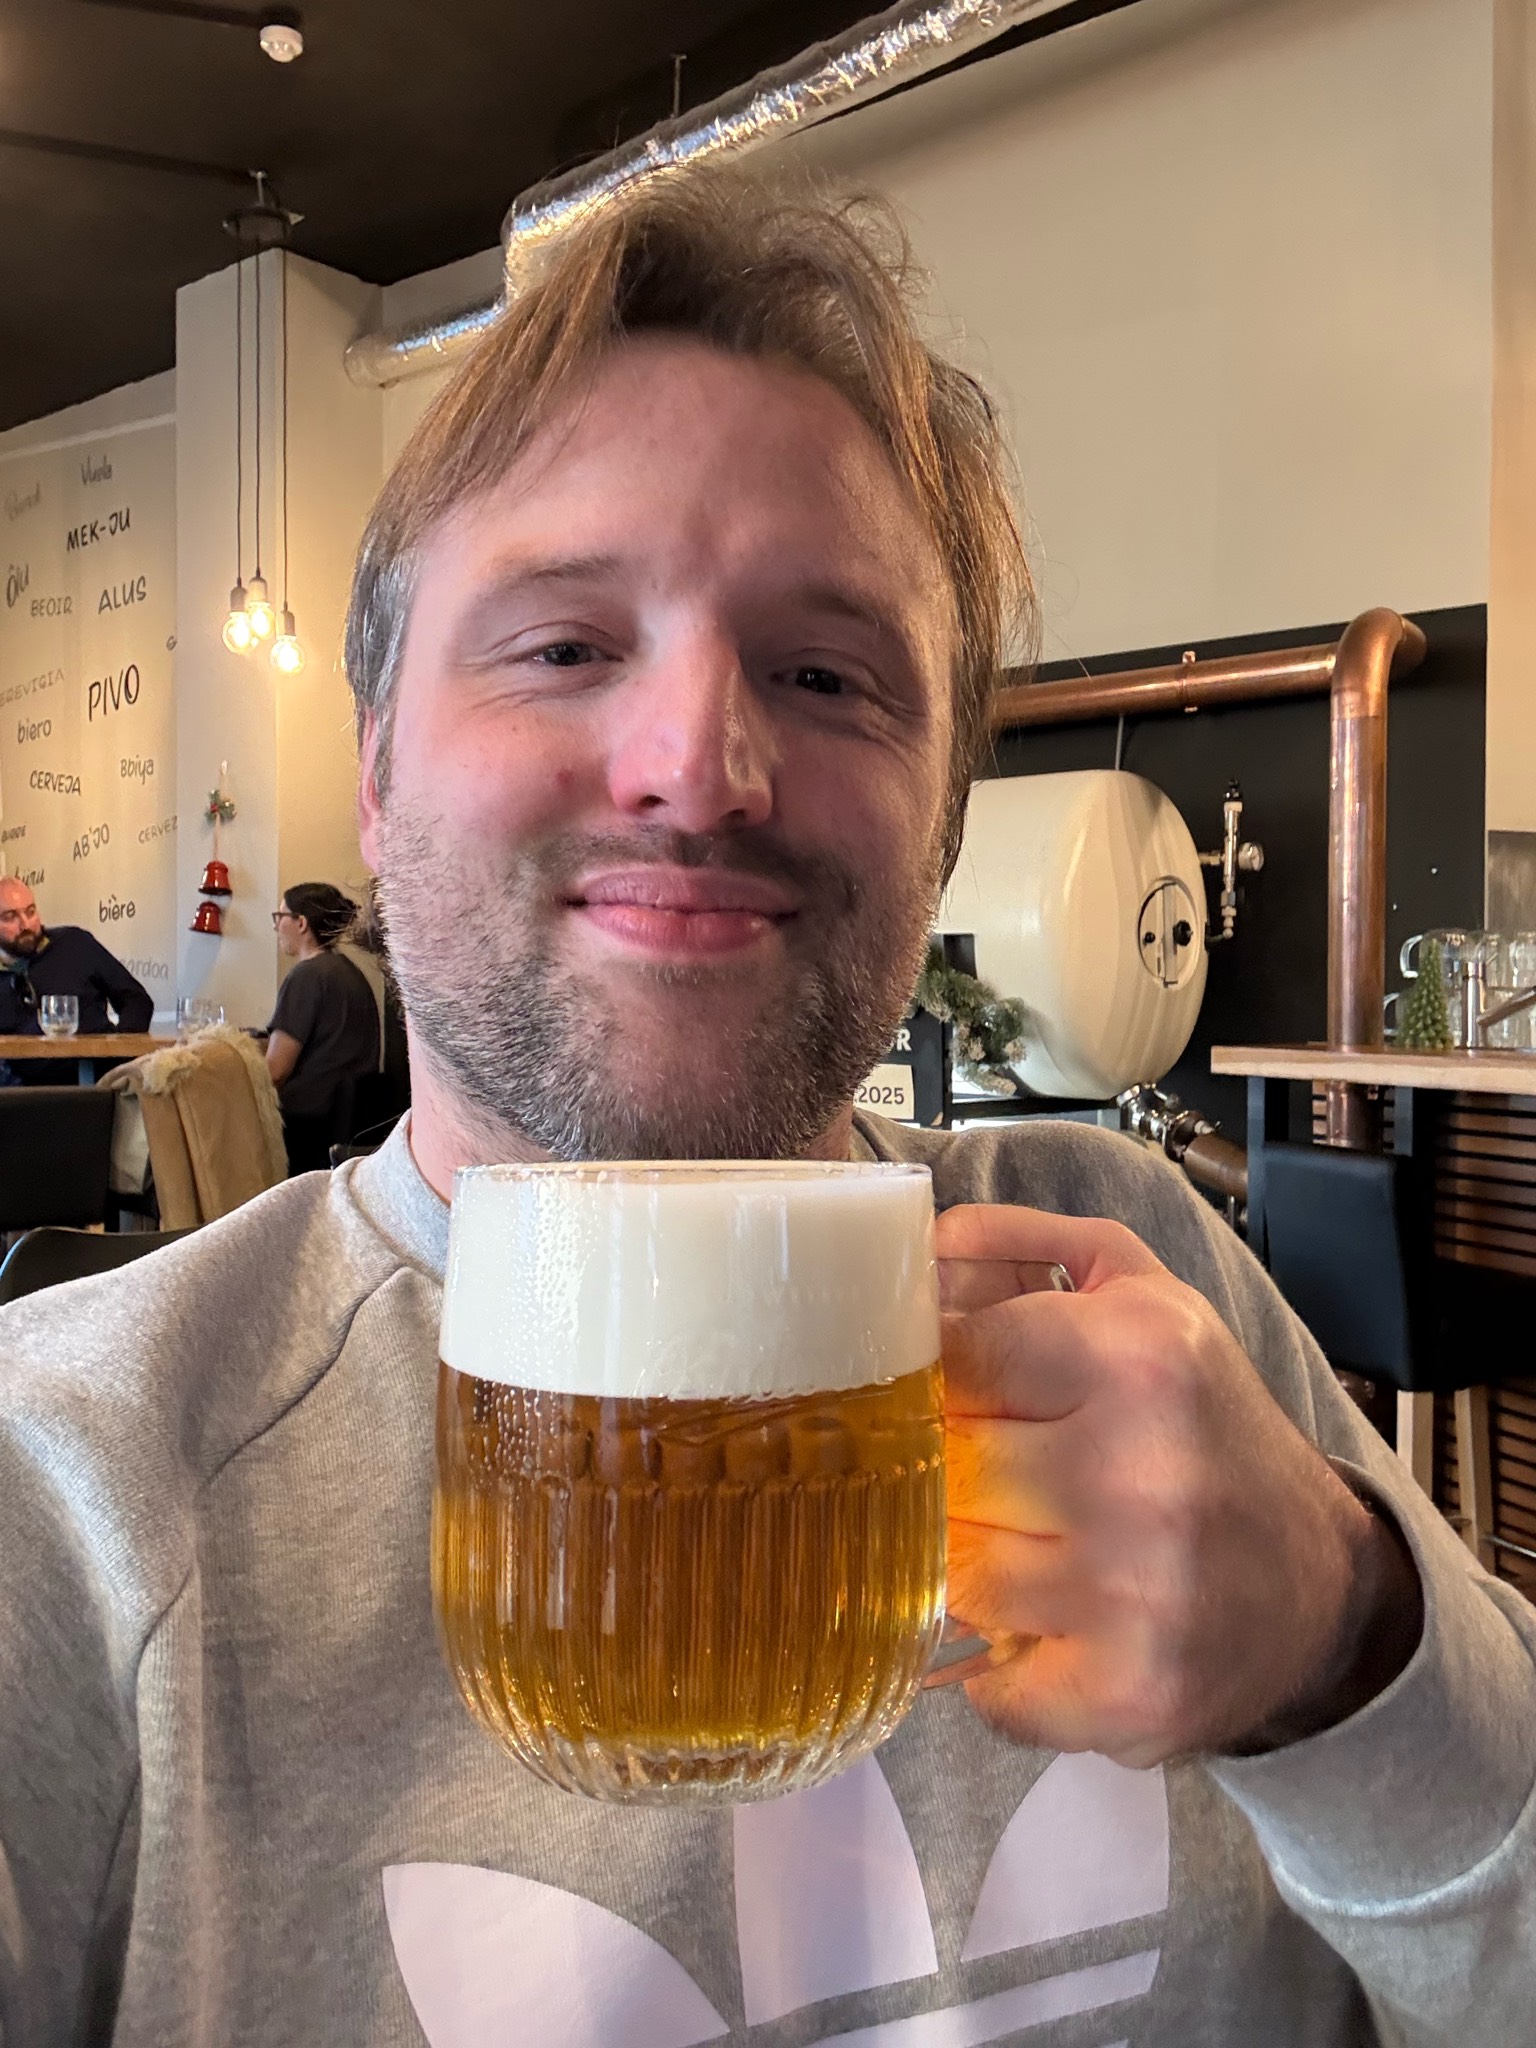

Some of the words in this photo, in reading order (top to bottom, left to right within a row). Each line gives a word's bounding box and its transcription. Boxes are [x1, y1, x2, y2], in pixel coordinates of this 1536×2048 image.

[67, 507, 130, 552] MEK-JU
[98, 575, 147, 615] ALUS
[88, 664, 140, 722] PIVO
[17, 718, 51, 743] biero
[29, 770, 81, 796] CERVEJA
[99, 894, 136, 923] bière
[858, 1086, 905, 1105] 2025
